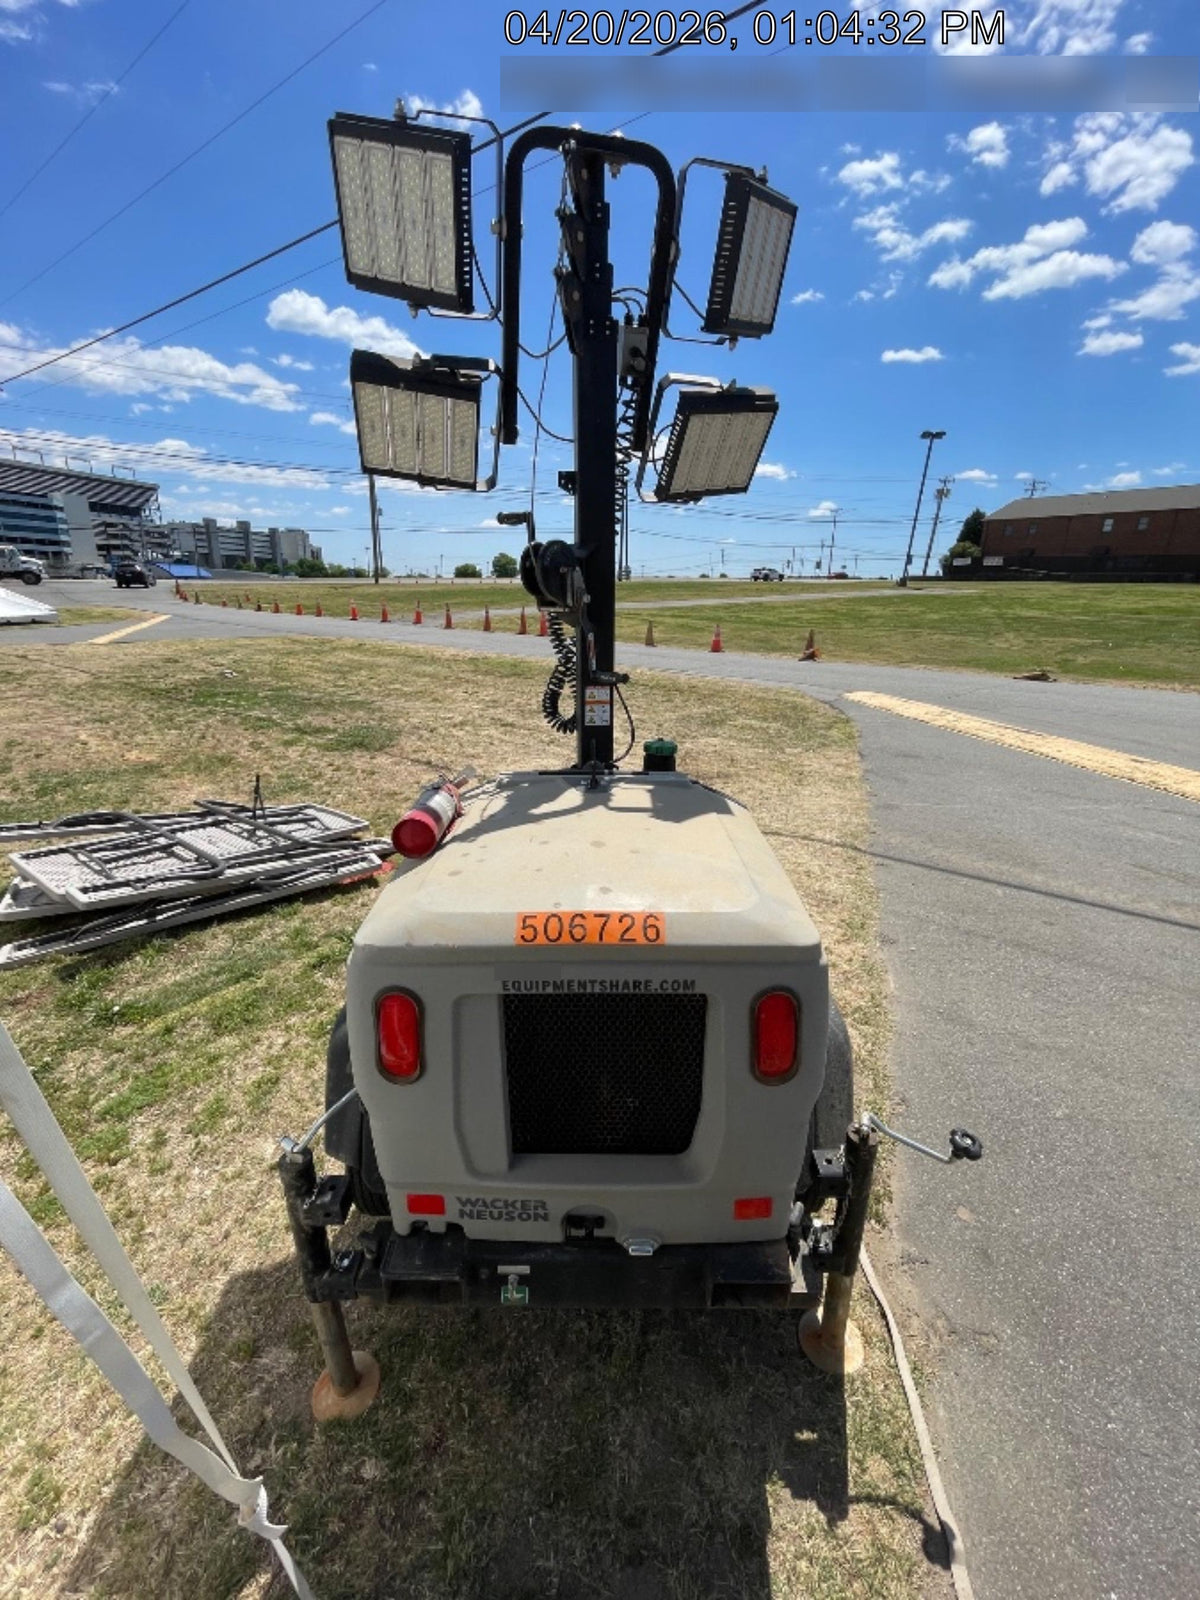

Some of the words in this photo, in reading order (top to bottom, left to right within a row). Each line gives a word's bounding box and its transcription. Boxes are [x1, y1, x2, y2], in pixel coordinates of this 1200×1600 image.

[520, 913, 661, 943] 506726
[502, 979, 696, 993] EQUIPMENTSHARE.COM
[456, 1197, 548, 1211] WACKER
[459, 1208, 549, 1222] NEUSON
